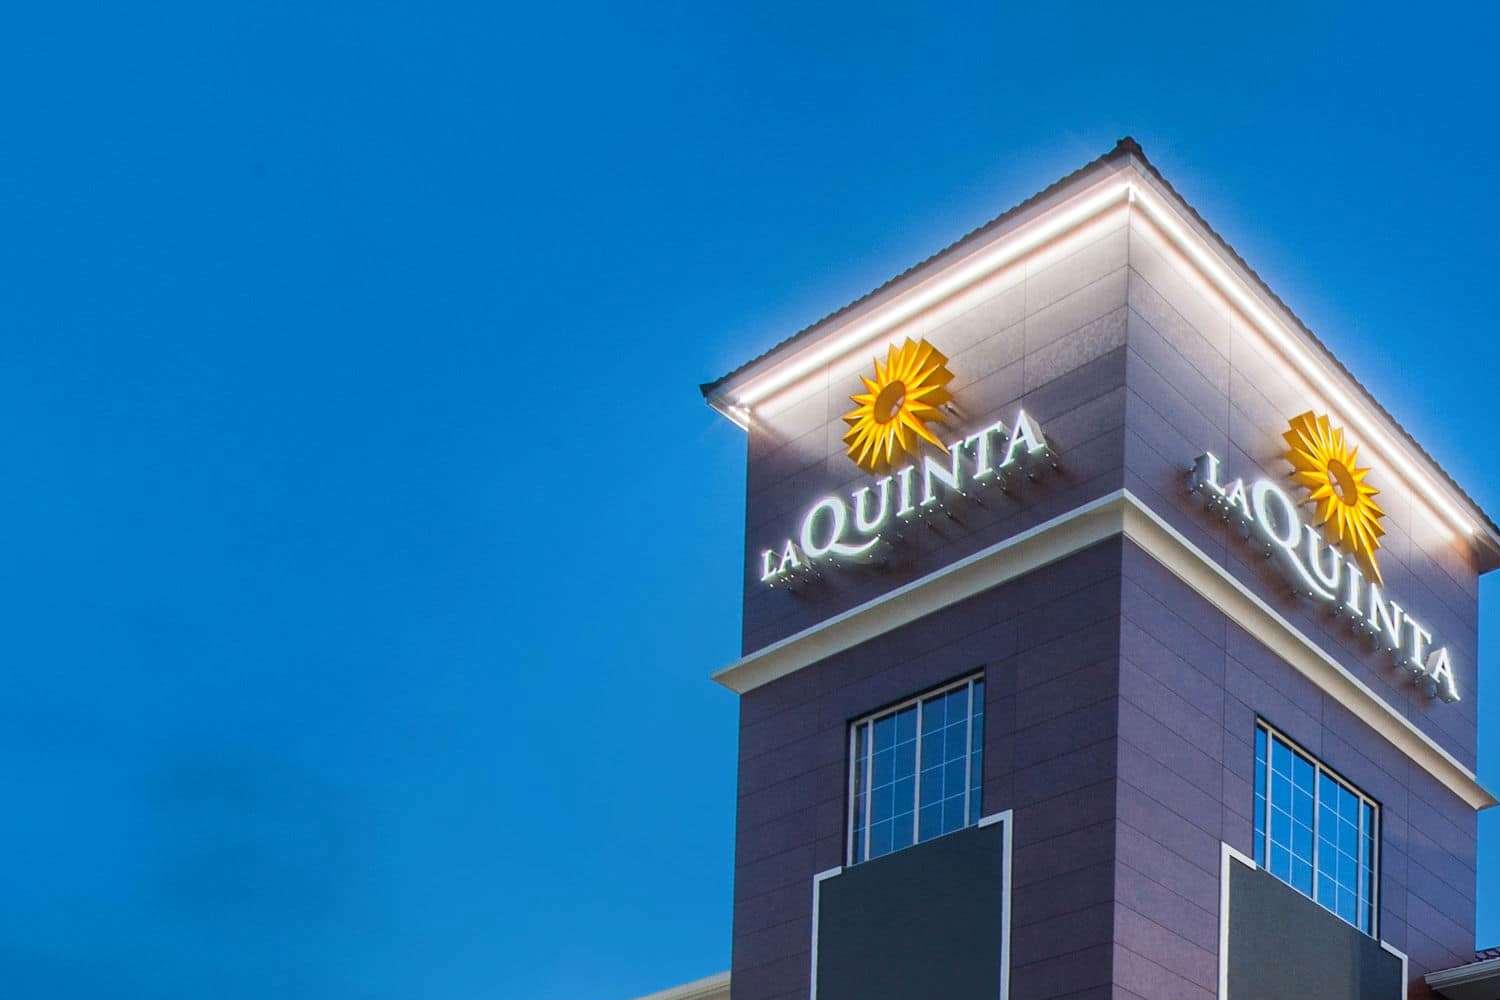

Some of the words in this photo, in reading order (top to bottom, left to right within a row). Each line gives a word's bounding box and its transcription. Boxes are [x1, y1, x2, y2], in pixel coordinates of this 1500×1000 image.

[760, 540, 801, 581] LA
[801, 409, 1048, 559] QUINTA
[1197, 452, 1254, 520] LA
[1252, 478, 1461, 701] QUINTA
